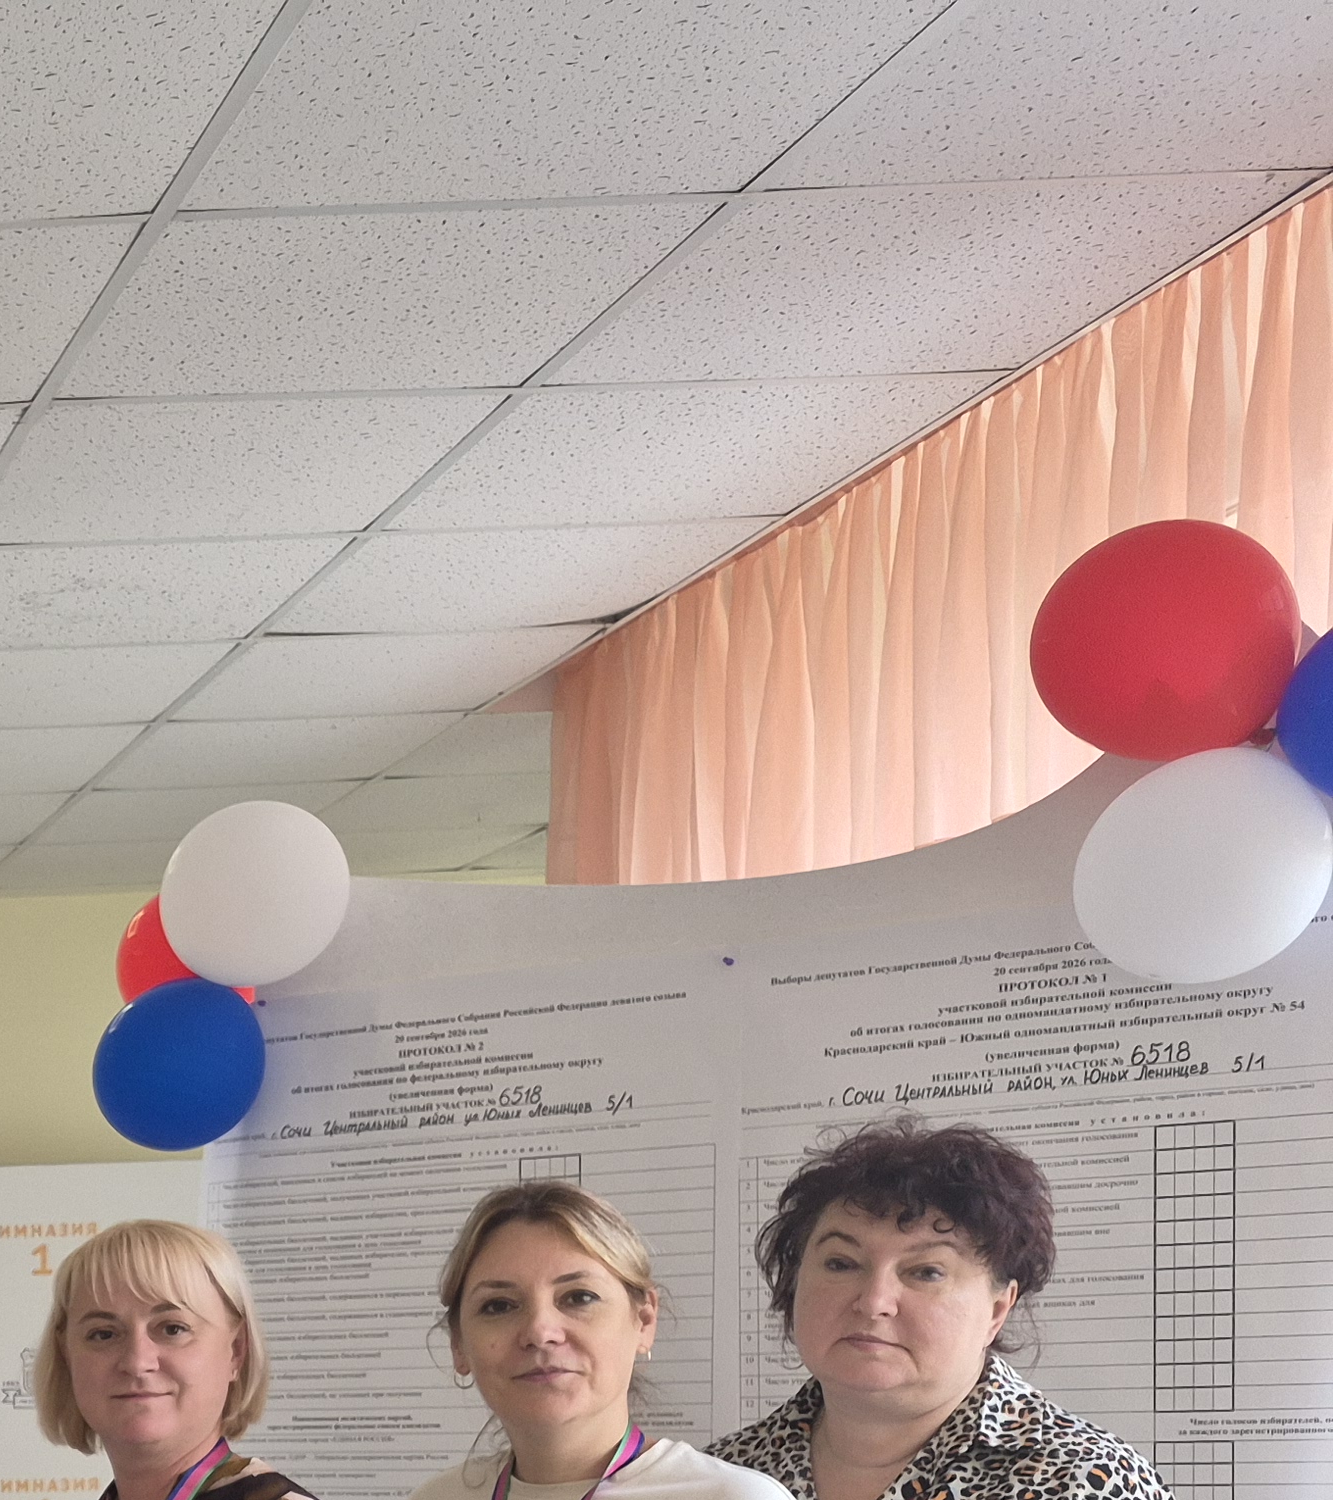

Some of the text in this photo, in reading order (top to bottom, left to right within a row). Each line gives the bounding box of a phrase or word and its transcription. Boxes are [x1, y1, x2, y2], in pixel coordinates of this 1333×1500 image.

[771, 974, 812, 986] Выборы
[814, 968, 866, 982] депутатов
[868, 957, 958, 975] Государственной
[959, 954, 991, 966] Думы
[994, 945, 1071, 960] Федерального
[993, 967, 1006, 977] 20
[1008, 962, 1058, 975] сентября
[1061, 958, 1087, 969] 2026
[998, 973, 1108, 993] ПРОТОКОЛ № 1
[850, 985, 1274, 1037] об итогах голосования по одномандатному избирательному округу
[937, 982, 1172, 1017] участковой избирательной комиссии
[395, 1034, 405, 1044] 20
[824, 1039, 914, 1059] Краснодарский
[917, 1035, 946, 1049] край
[960, 1026, 1011, 1044] Южный
[1014, 1019, 1115, 1038] одномандатный
[1120, 1009, 1223, 1028] избирательный
[1227, 1005, 1267, 1020] округ
[1269, 1002, 1286, 1013] №
[1289, 1000, 1306, 1012] 54
[398, 1043, 462, 1059] ПРОТОКОЛ
[477, 1041, 484, 1051] 2
[985, 1040, 1120, 1063] (увеличенная форма)
[1130, 1040, 1191, 1067] 6518
[291, 1085, 302, 1095] об
[568, 1056, 603, 1069] округу
[842, 1086, 885, 1107] Сочи
[1084, 1068, 1129, 1085] Юных
[1134, 1061, 1209, 1081] Ленинцев
[1231, 1052, 1266, 1074] 5/1
[932, 1056, 1124, 1083] ИЗБИРАТЕЛЬНЫЙ УЧАСТОК №
[349, 1101, 433, 1119] ИЗБИРАТЕЛЬНЫЙ
[435, 1098, 484, 1113] УЧАСТОК
[499, 1084, 543, 1108] 6518
[280, 1124, 312, 1140] Сочи
[483, 1106, 521, 1123] Юных
[528, 1101, 593, 1118] Ленинцев
[606, 1091, 633, 1116] 5/1
[31, 1244, 53, 1276] 1
